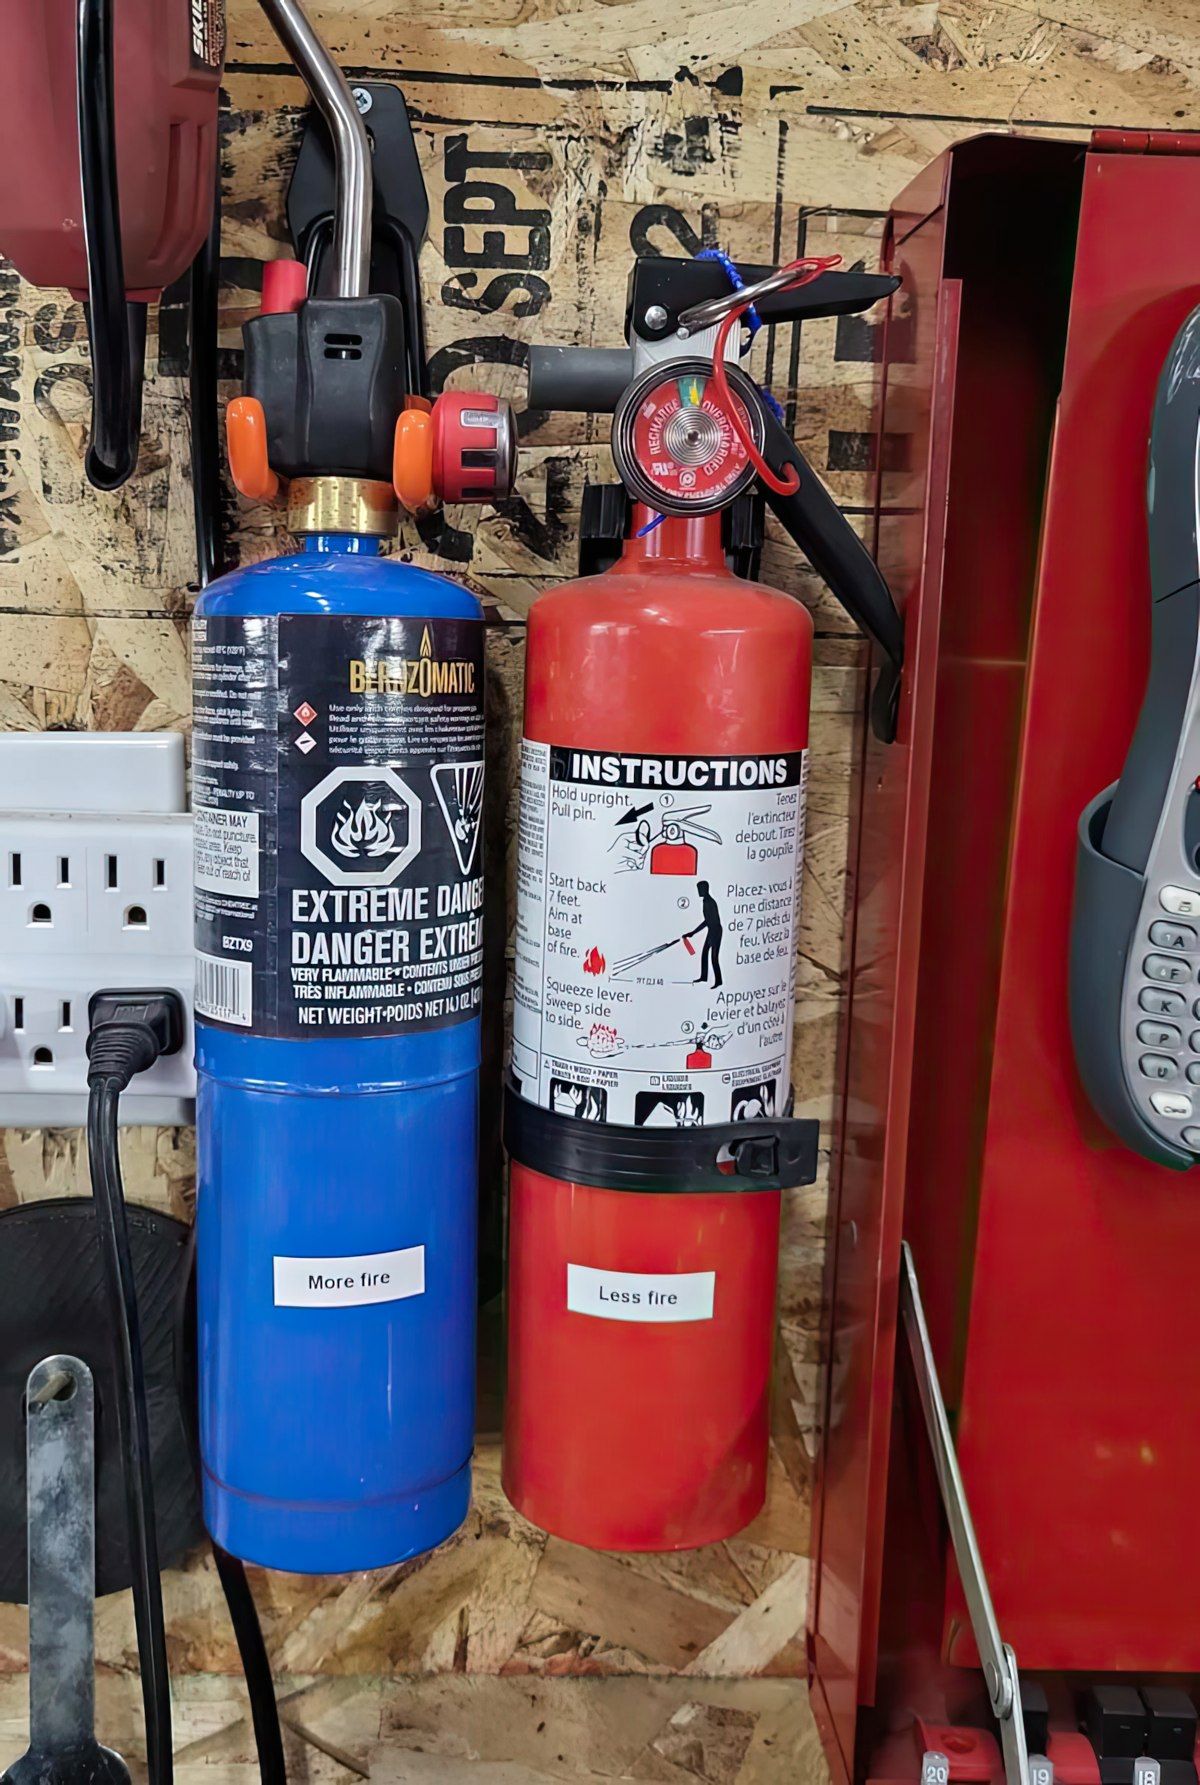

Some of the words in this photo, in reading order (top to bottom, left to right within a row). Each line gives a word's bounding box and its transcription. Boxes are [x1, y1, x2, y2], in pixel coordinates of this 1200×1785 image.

[441, 133, 553, 318] SEPT
[572, 754, 788, 787] INSTRUCTIONS
[552, 783, 577, 801] Hold
[581, 790, 633, 808] upright.
[552, 802, 571, 818] Pull
[573, 806, 596, 821] pin.
[229, 815, 248, 828] MAY
[746, 846, 756, 860] la
[549, 872, 573, 889] Start
[577, 878, 607, 894] back
[292, 888, 428, 922] EXTREME
[437, 876, 484, 917] DANGE
[549, 889, 555, 901] 7
[733, 903, 755, 915] une
[571, 913, 582, 924] at
[728, 918, 744, 932] de
[548, 922, 572, 940] base
[291, 930, 409, 965] DANGER
[547, 941, 557, 953] of
[1172, 936, 1185, 948] A
[736, 952, 762, 966] base
[291, 967, 319, 982] VERY
[322, 967, 392, 982] FLAMMABLE
[403, 961, 448, 979] CONTENTS
[1170, 968, 1179, 980] F
[293, 982, 322, 999] TRÈS
[325, 983, 404, 999] INFLAMMABLE
[546, 976, 594, 999] Squeeze
[597, 986, 633, 1003] lever.
[299, 1006, 325, 1024] NET
[425, 998, 444, 1017] NET
[546, 993, 582, 1015] Sweep
[584, 1002, 611, 1018] side
[706, 1008, 741, 1021] levier
[743, 1006, 754, 1017] et
[1160, 1001, 1171, 1013] K
[545, 1011, 556, 1023] to
[557, 1013, 584, 1029] side.
[737, 1020, 761, 1036] d'un
[1159, 1034, 1169, 1044] P
[308, 1275, 354, 1289] More
[361, 1272, 390, 1287] fire
[600, 1285, 641, 1304] Less
[648, 1290, 678, 1305] fire
[926, 1766, 946, 1784] 20
[1032, 1769, 1050, 1785] 19
